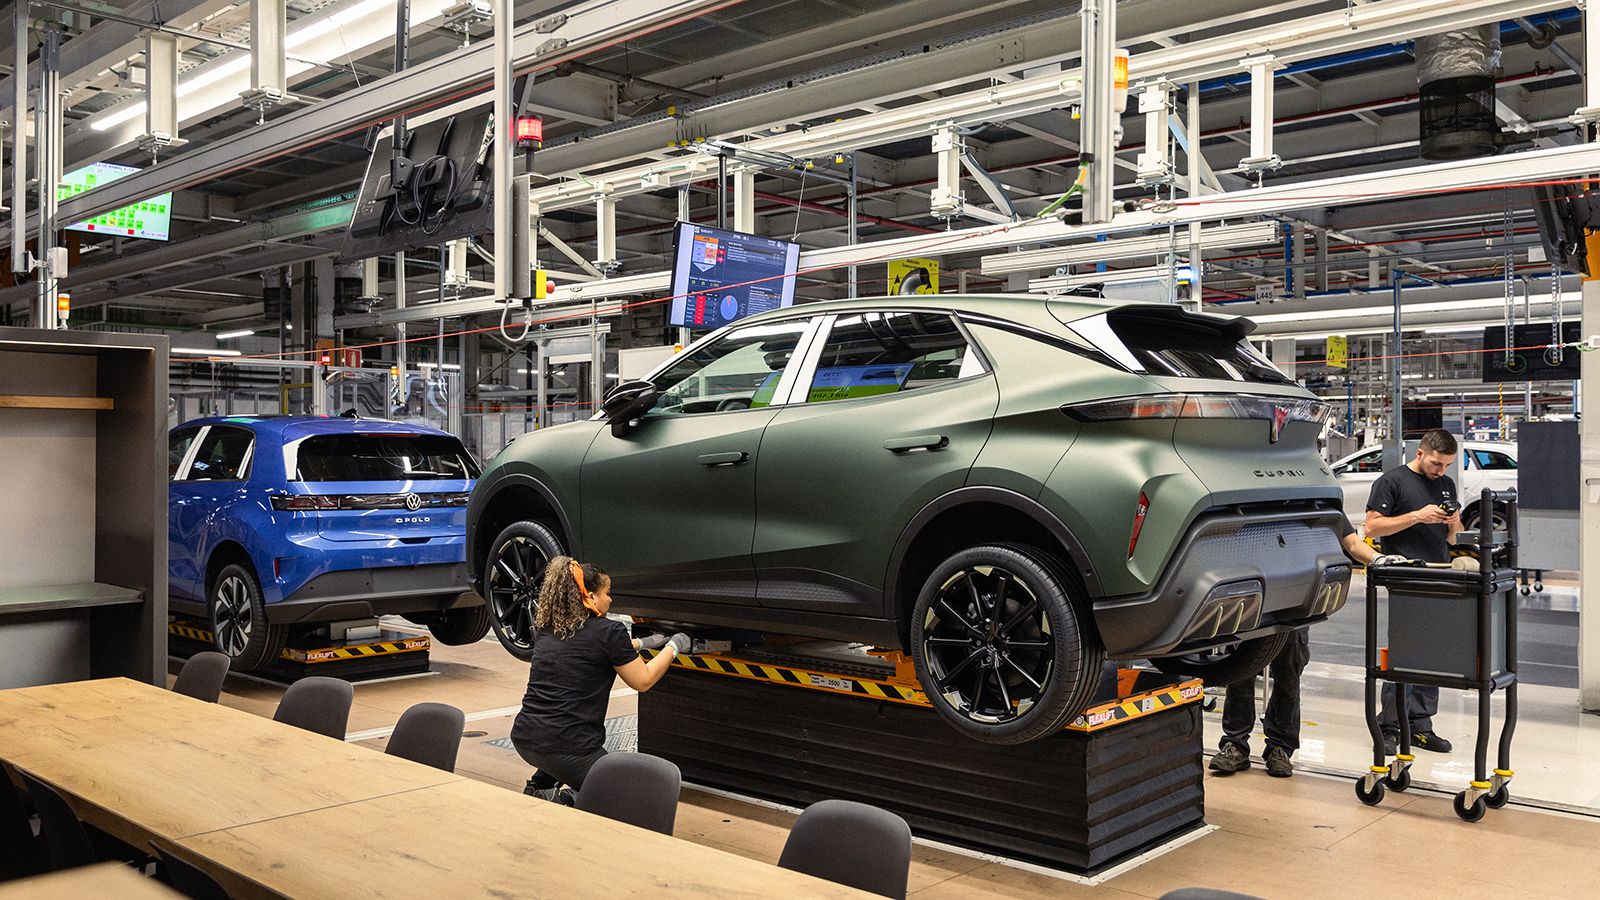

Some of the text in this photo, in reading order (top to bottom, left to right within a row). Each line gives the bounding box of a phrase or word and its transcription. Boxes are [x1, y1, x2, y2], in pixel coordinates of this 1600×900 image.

[1256, 291, 1273, 300] L445
[827, 679, 841, 687] 2500
[1145, 699, 1151, 711] 2
[1088, 709, 1116, 726] FLEXLIFT
